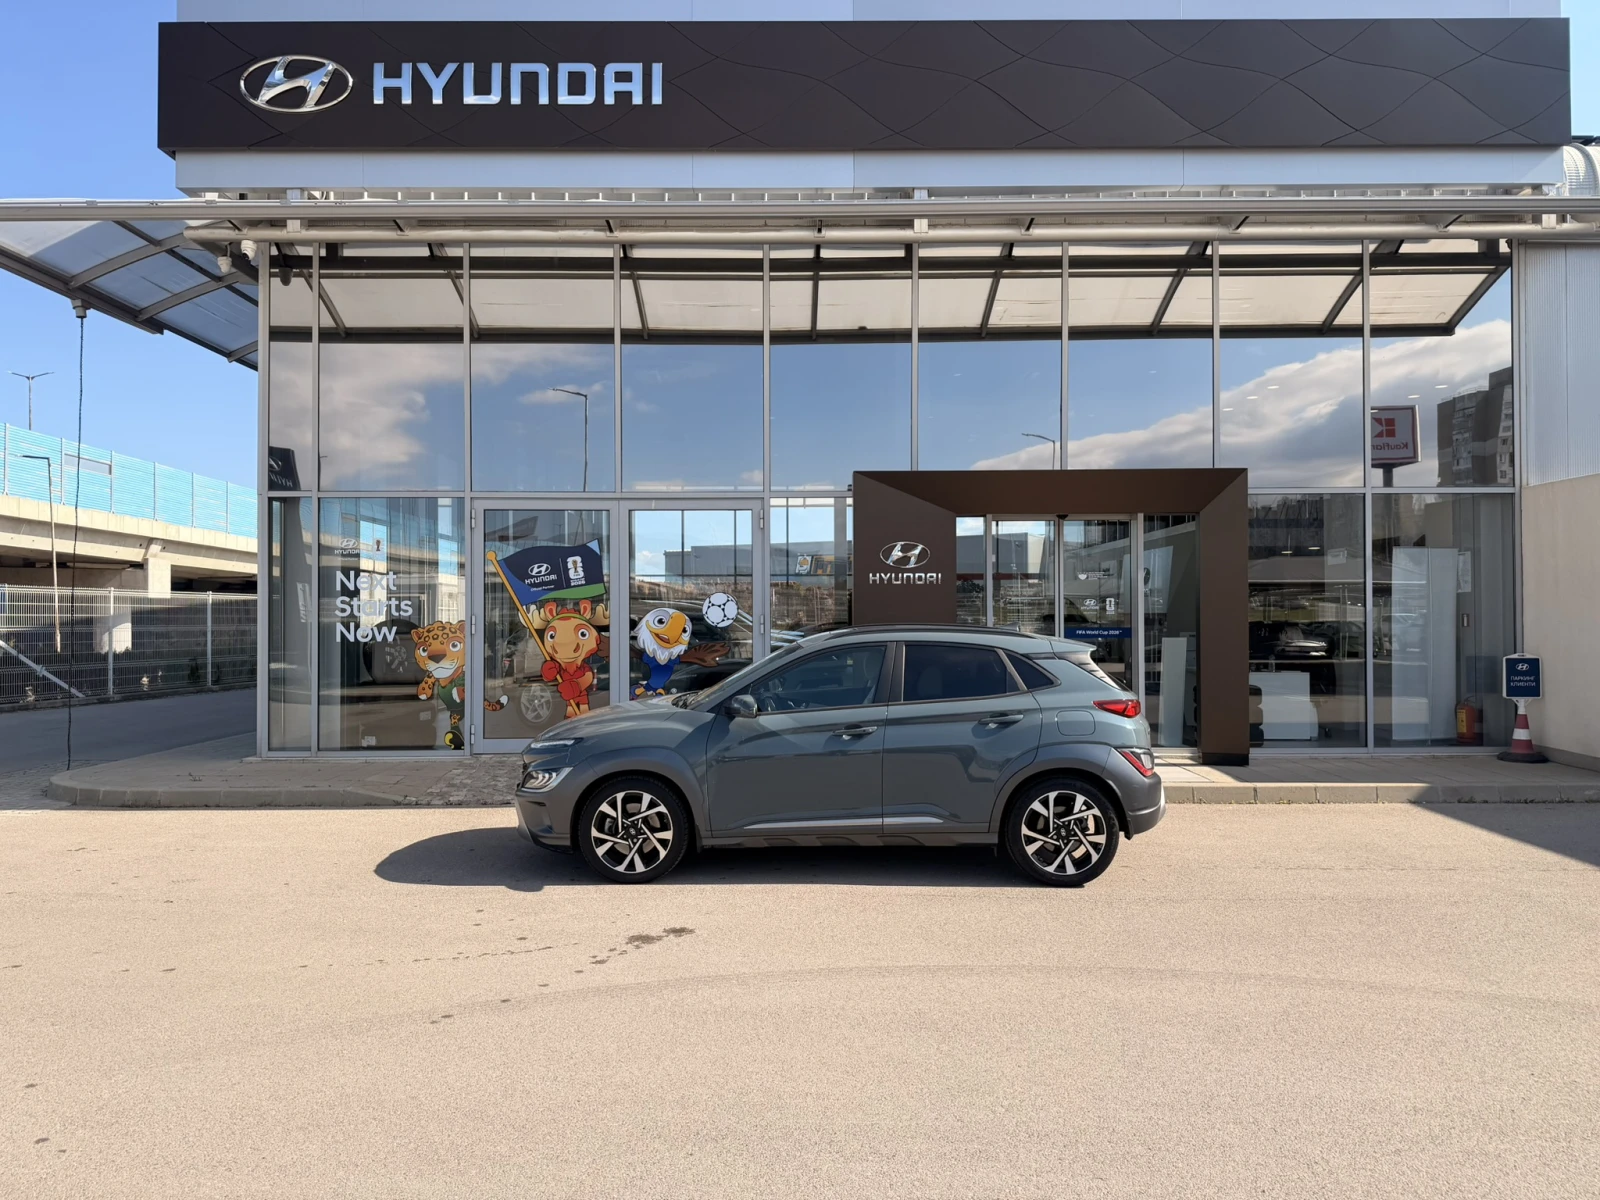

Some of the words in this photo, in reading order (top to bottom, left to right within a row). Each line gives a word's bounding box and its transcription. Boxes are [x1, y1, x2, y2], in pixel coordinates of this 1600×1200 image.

[373, 62, 663, 105] HYUNDAI
[335, 570, 397, 591] Next
[525, 574, 557, 584] HYUNDAI
[869, 572, 942, 585] HYUNDAI
[334, 595, 413, 617] Starts
[335, 621, 398, 643] Now
